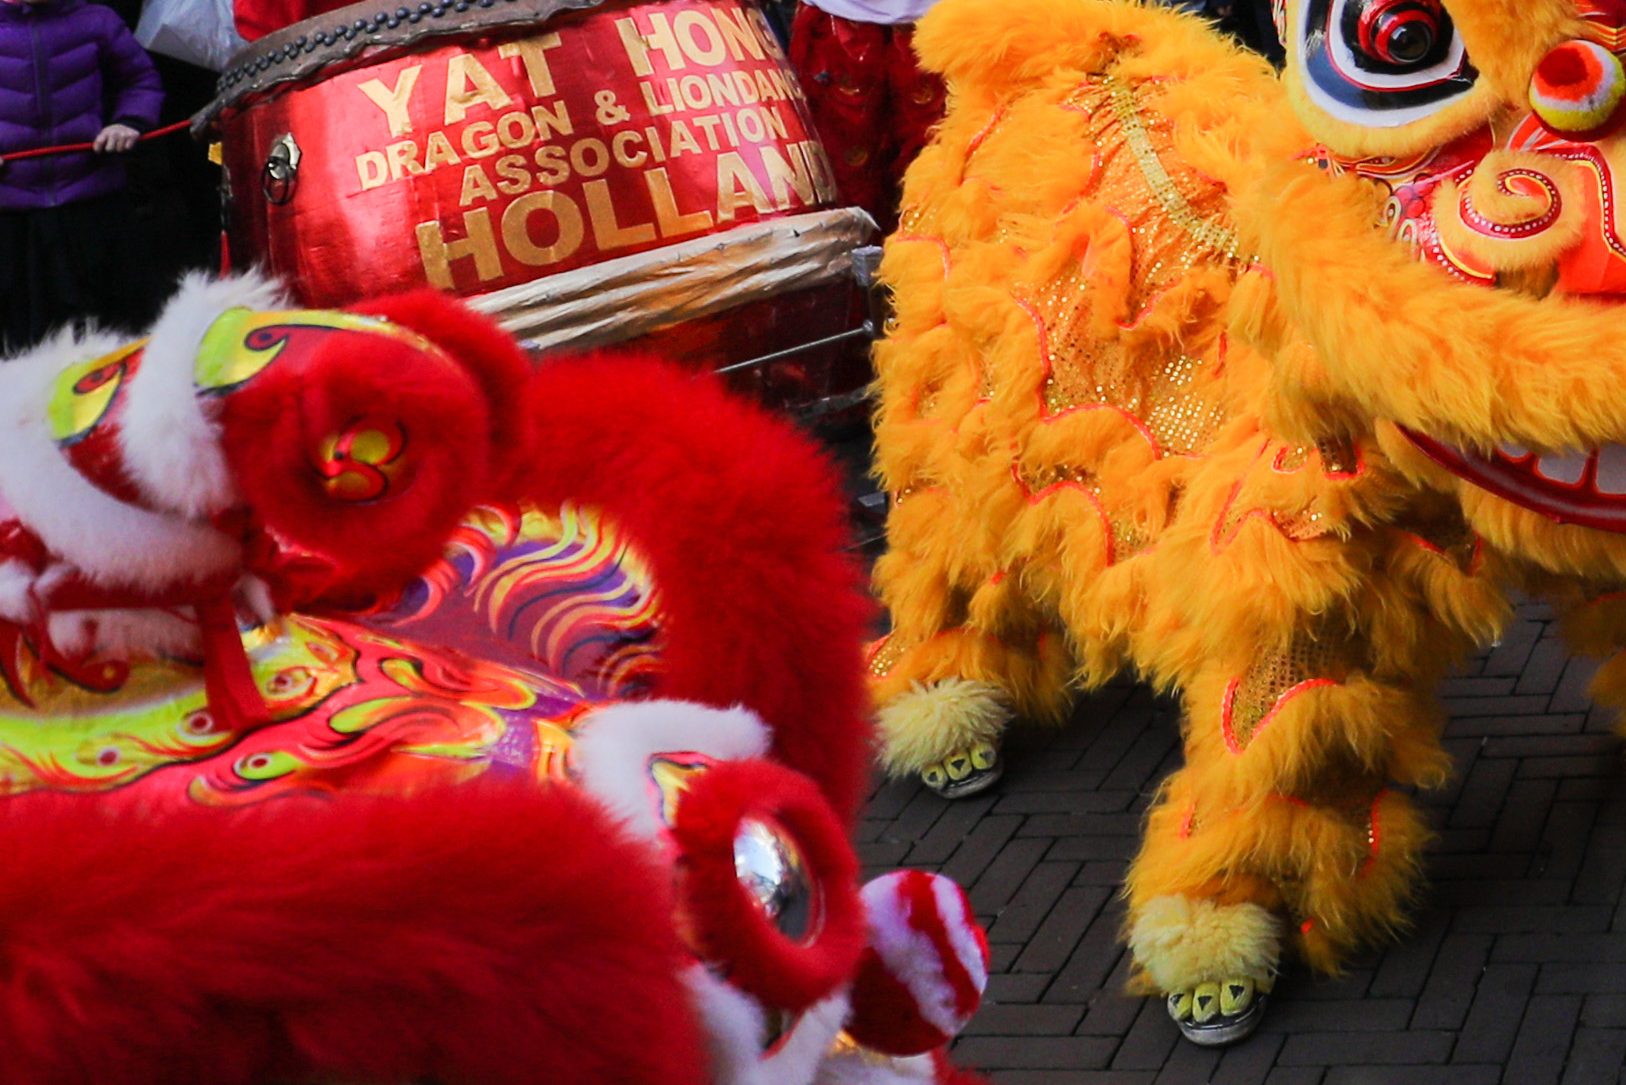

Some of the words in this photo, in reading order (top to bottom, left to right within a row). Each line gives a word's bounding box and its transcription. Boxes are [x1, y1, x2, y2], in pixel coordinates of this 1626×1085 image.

[357, 32, 562, 138] YAT
[615, 7, 785, 78] HONG
[355, 100, 574, 191] DRAGON
[594, 90, 631, 126] &
[459, 106, 789, 207] ASSOCIATION
[415, 140, 838, 290] HOLLAND
